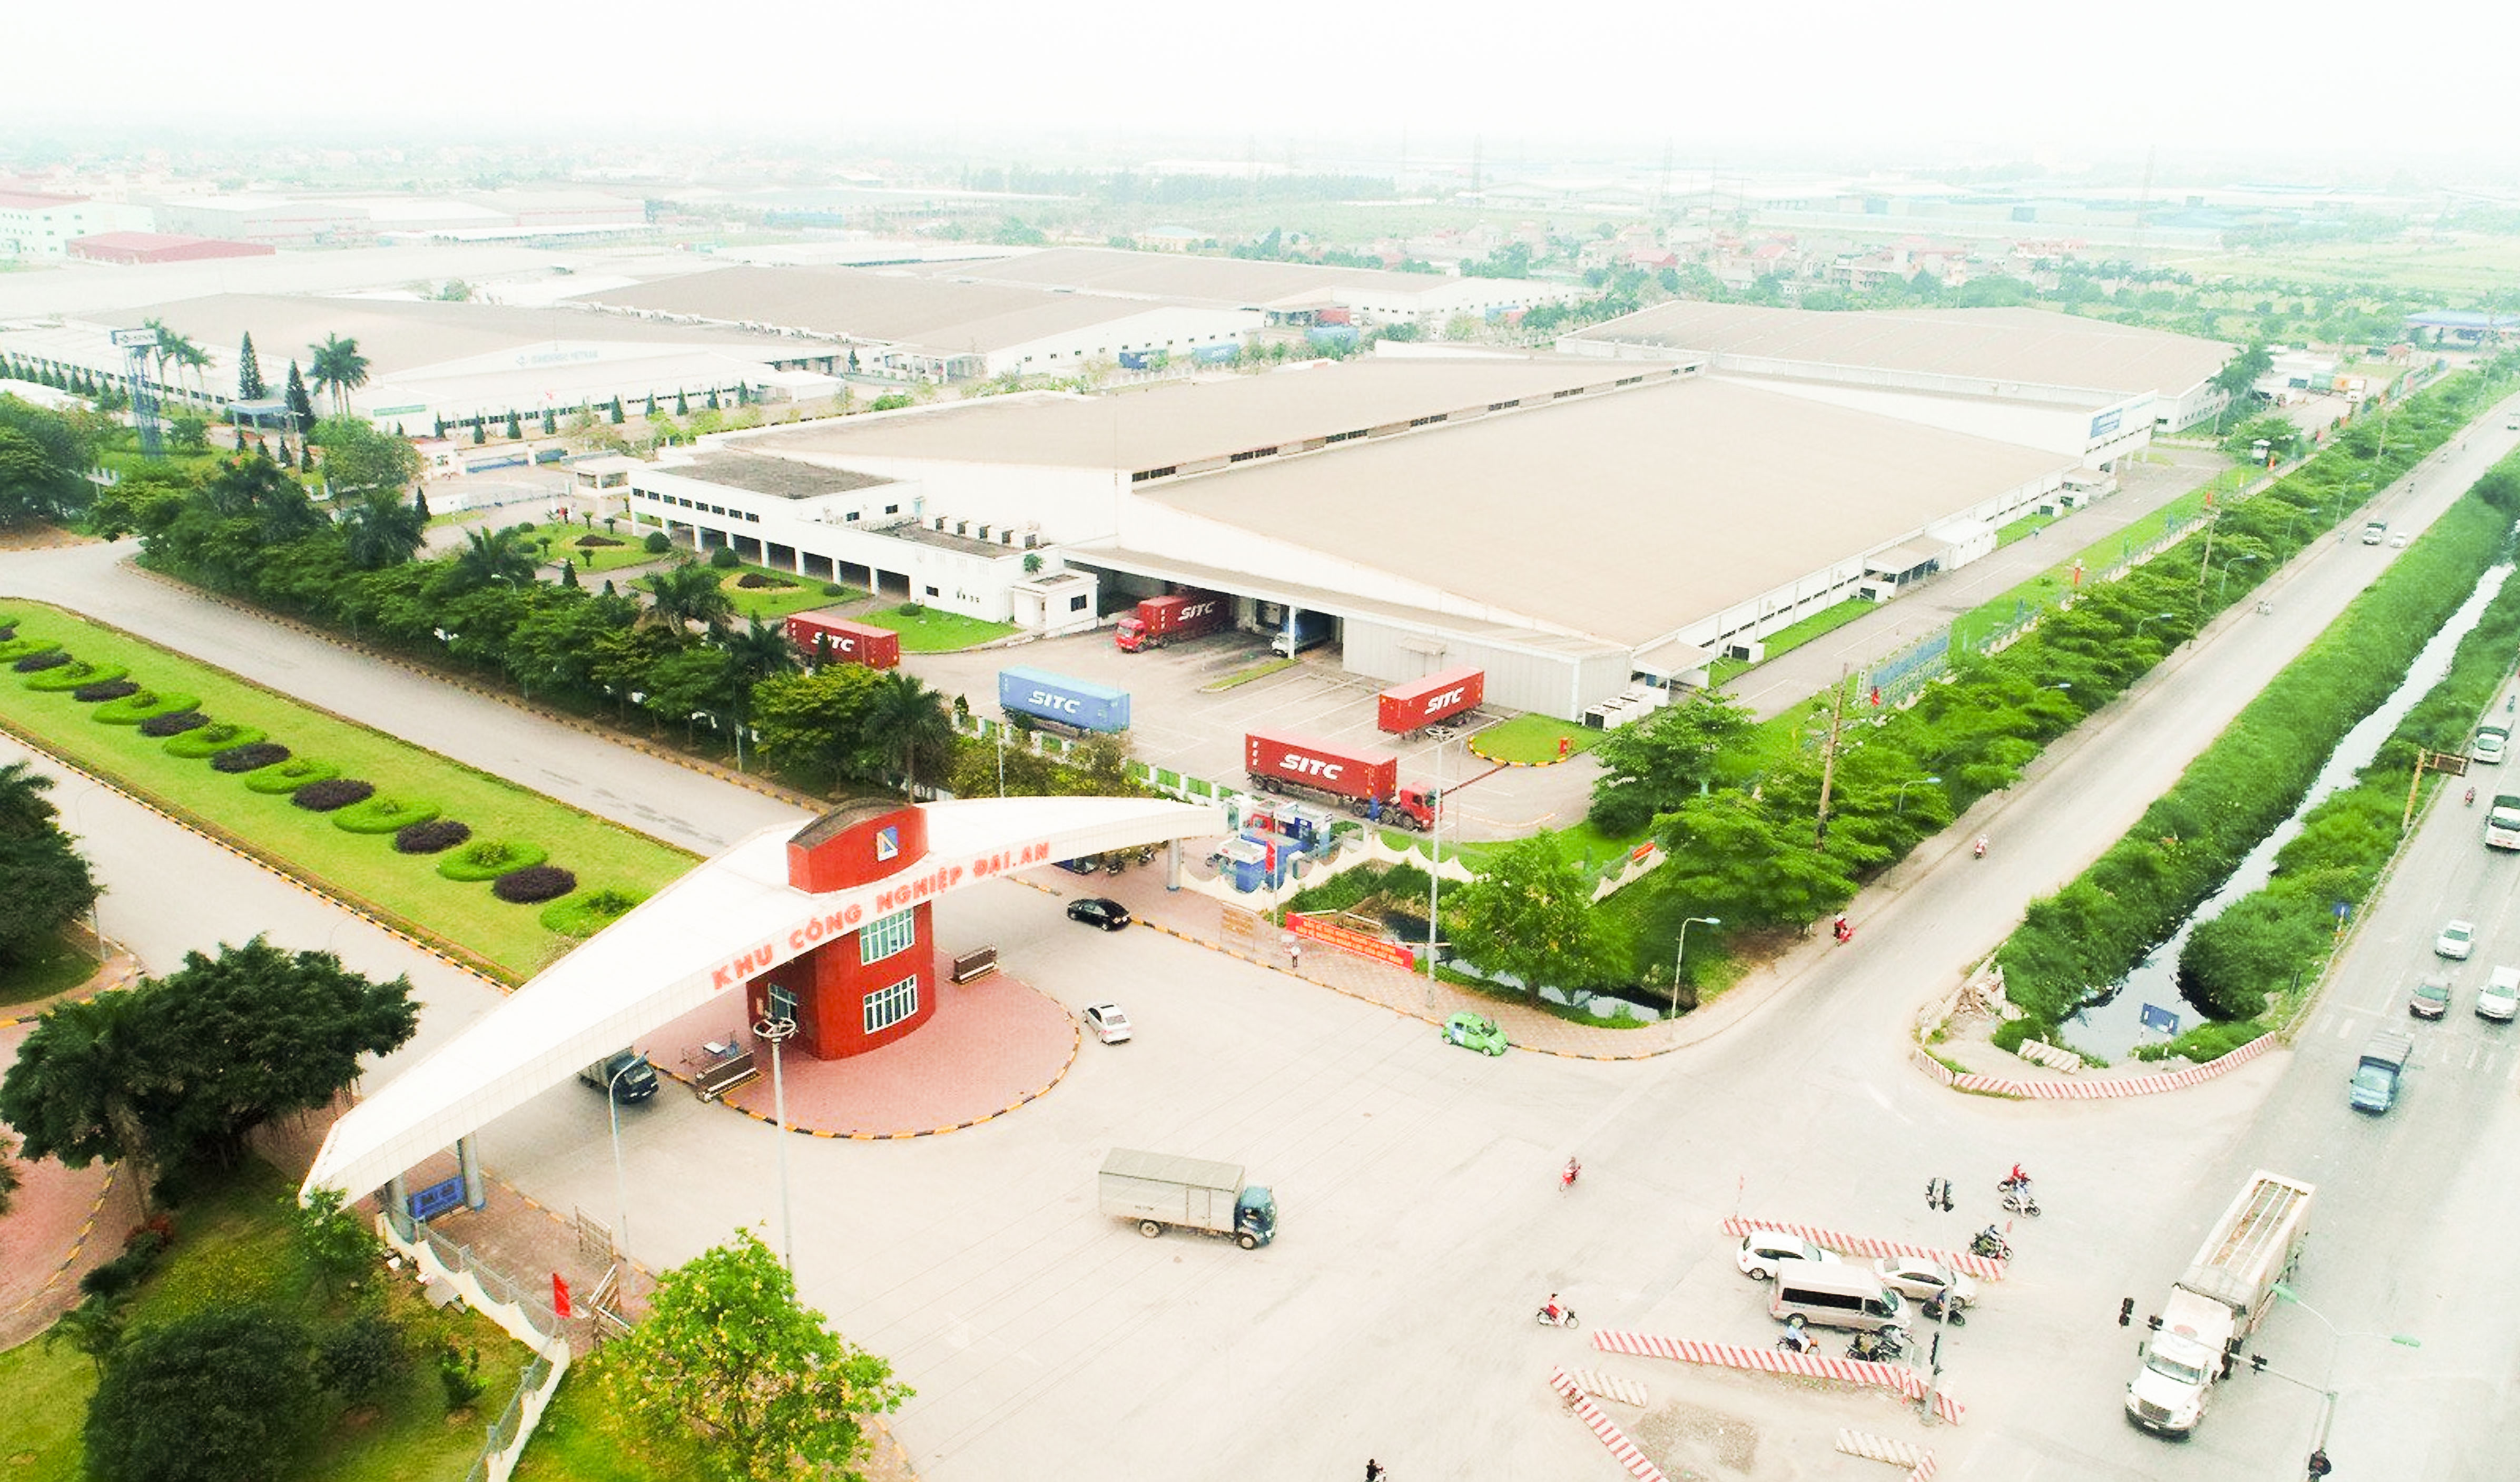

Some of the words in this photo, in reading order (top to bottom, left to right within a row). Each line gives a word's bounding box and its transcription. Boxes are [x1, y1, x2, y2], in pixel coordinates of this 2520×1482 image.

[1177, 601, 1216, 621] SITC
[811, 632, 854, 652] STC
[1028, 691, 1080, 714] SITC
[1424, 687, 1464, 714] SITC
[1279, 754, 1343, 780] SITC
[712, 944, 773, 989] KHU
[789, 904, 862, 949] CÔNG
[877, 866, 962, 913] NGHIỆP
